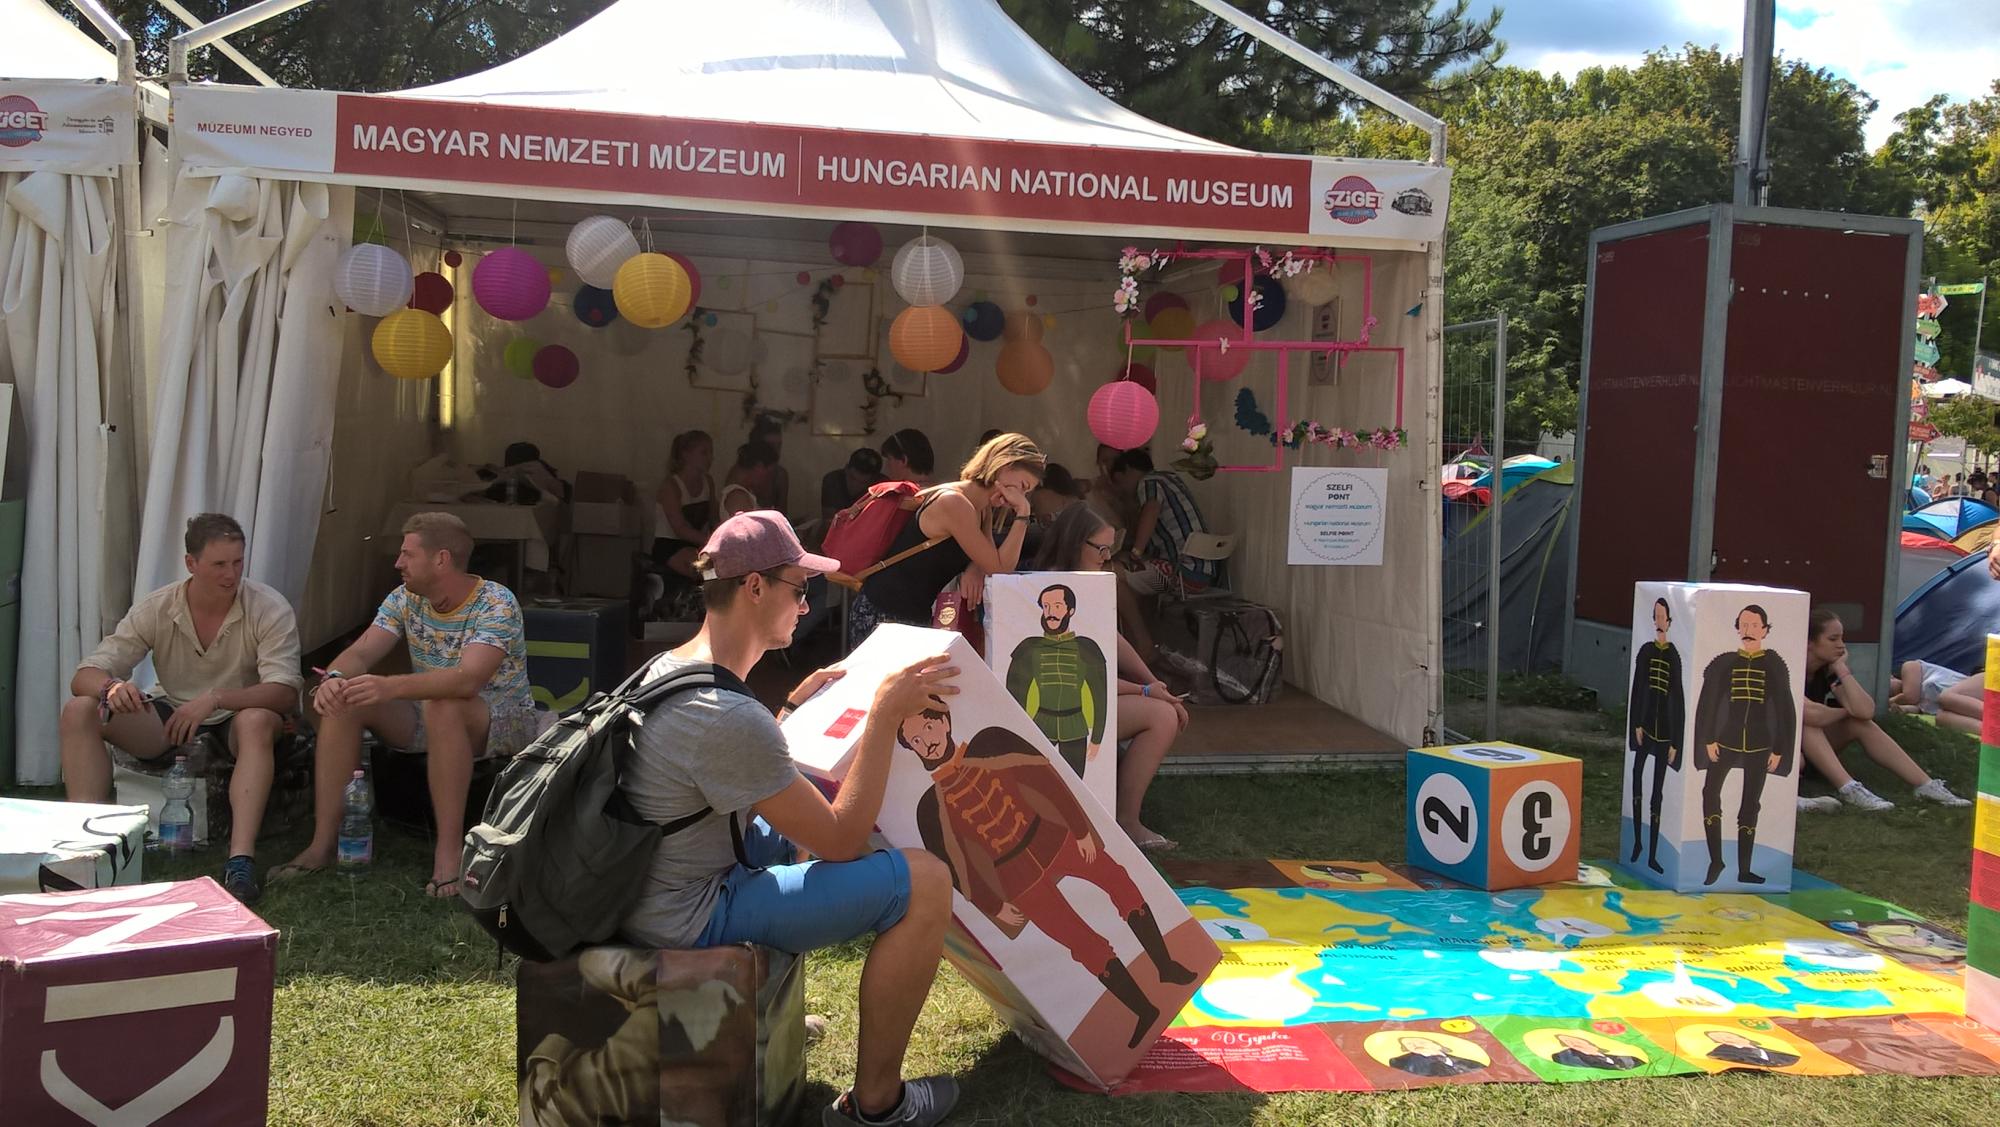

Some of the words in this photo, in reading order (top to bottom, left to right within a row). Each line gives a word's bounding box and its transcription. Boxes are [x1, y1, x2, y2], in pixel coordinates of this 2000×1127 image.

[197, 122, 256, 135] MÚZEUMI
[260, 126, 312, 138] NEGYED
[353, 124, 490, 158] MAGYAR
[499, 133, 639, 168] NEMZETI
[649, 140, 786, 178] MÚZEUM
[817, 155, 1001, 193] HUNGARIAN
[1010, 168, 1158, 202] NATIONAL
[1166, 178, 1294, 210] MUSEUM
[1423, 796, 1469, 843] 2
[1522, 791, 1552, 860] 3
